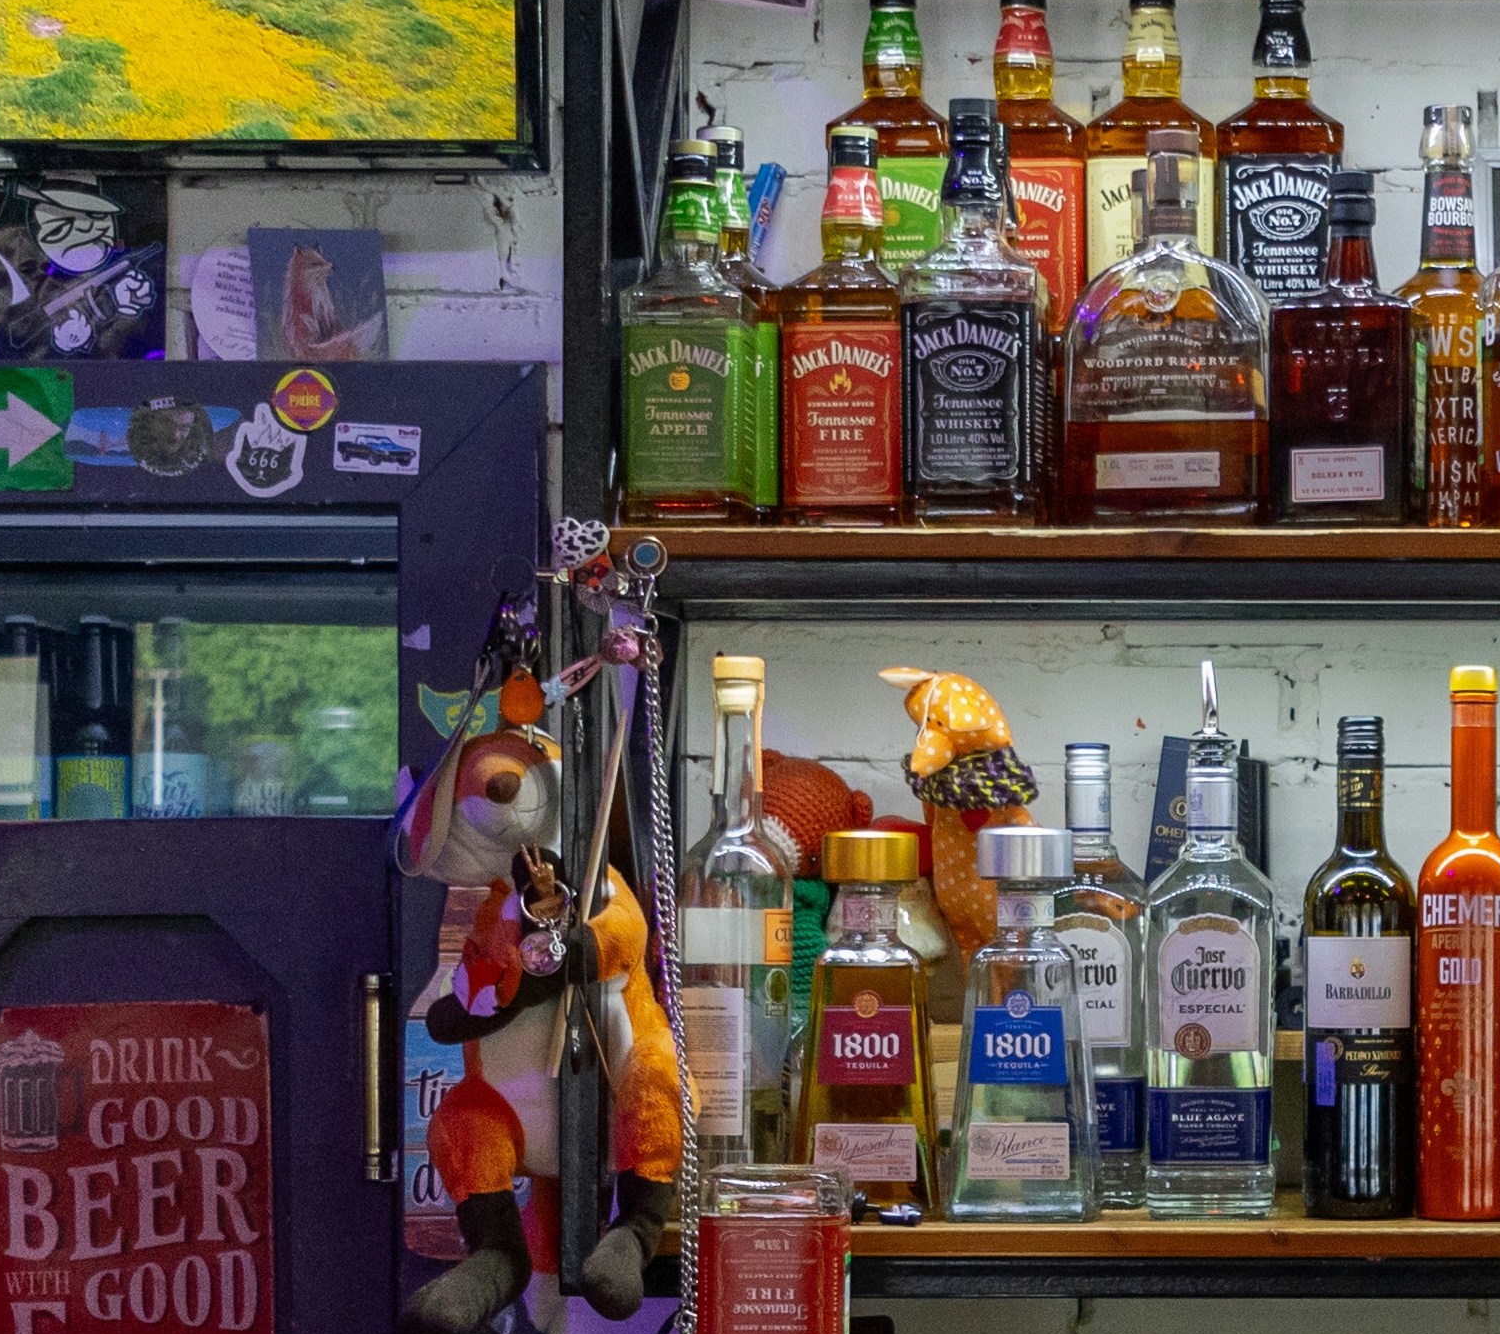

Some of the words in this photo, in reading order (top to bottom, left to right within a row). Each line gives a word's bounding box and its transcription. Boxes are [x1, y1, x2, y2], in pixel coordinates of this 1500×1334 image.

[881, 177, 942, 210] DANIEL'S
[1268, 213, 1302, 227] No.7
[1252, 242, 1318, 256] Tennessee
[1254, 264, 1318, 276] WHISKEY
[1265, 279, 1283, 290] Litre
[1285, 279, 1303, 289] 40%
[1305, 278, 1322, 289] Vol.
[913, 327, 951, 361] JACK
[951, 317, 1022, 360] DANIEL'S
[792, 346, 830, 379] JACK
[831, 340, 894, 379] DANIEL'S
[1084, 357, 1164, 368] WOODFORD
[1169, 356, 1238, 367] RESERVE
[950, 363, 987, 380] No.7
[289, 395, 320, 407] PADRE
[932, 393, 1004, 412] Tennessee
[807, 412, 876, 427] Tennessee
[934, 417, 1003, 431] WHISKEY
[650, 424, 708, 436] APPLE
[819, 429, 865, 442] FIRE
[250, 452, 280, 469] 666
[1196, 947, 1226, 968] Jose
[1171, 959, 1247, 997] Cuervo
[1438, 957, 1481, 985] GOLD
[1325, 984, 1391, 1001] BARBADILLO
[1179, 1004, 1245, 1014] ESPECIAL
[833, 1033, 899, 1059] 1800
[984, 1033, 1051, 1059] 1800
[89, 1036, 214, 1086] DRINK
[846, 1061, 890, 1070] TEQUILA
[997, 1062, 1041, 1070] TEQUILA
[87, 1096, 261, 1150] GOOD
[1171, 1113, 1199, 1123] BLUE
[1203, 1113, 1245, 1123] AGAVE
[3, 1144, 260, 1263] BEER
[5, 1269, 71, 1298] WITH
[84, 1249, 260, 1334] GOOD
[745, 1288, 796, 1300] FIRE
